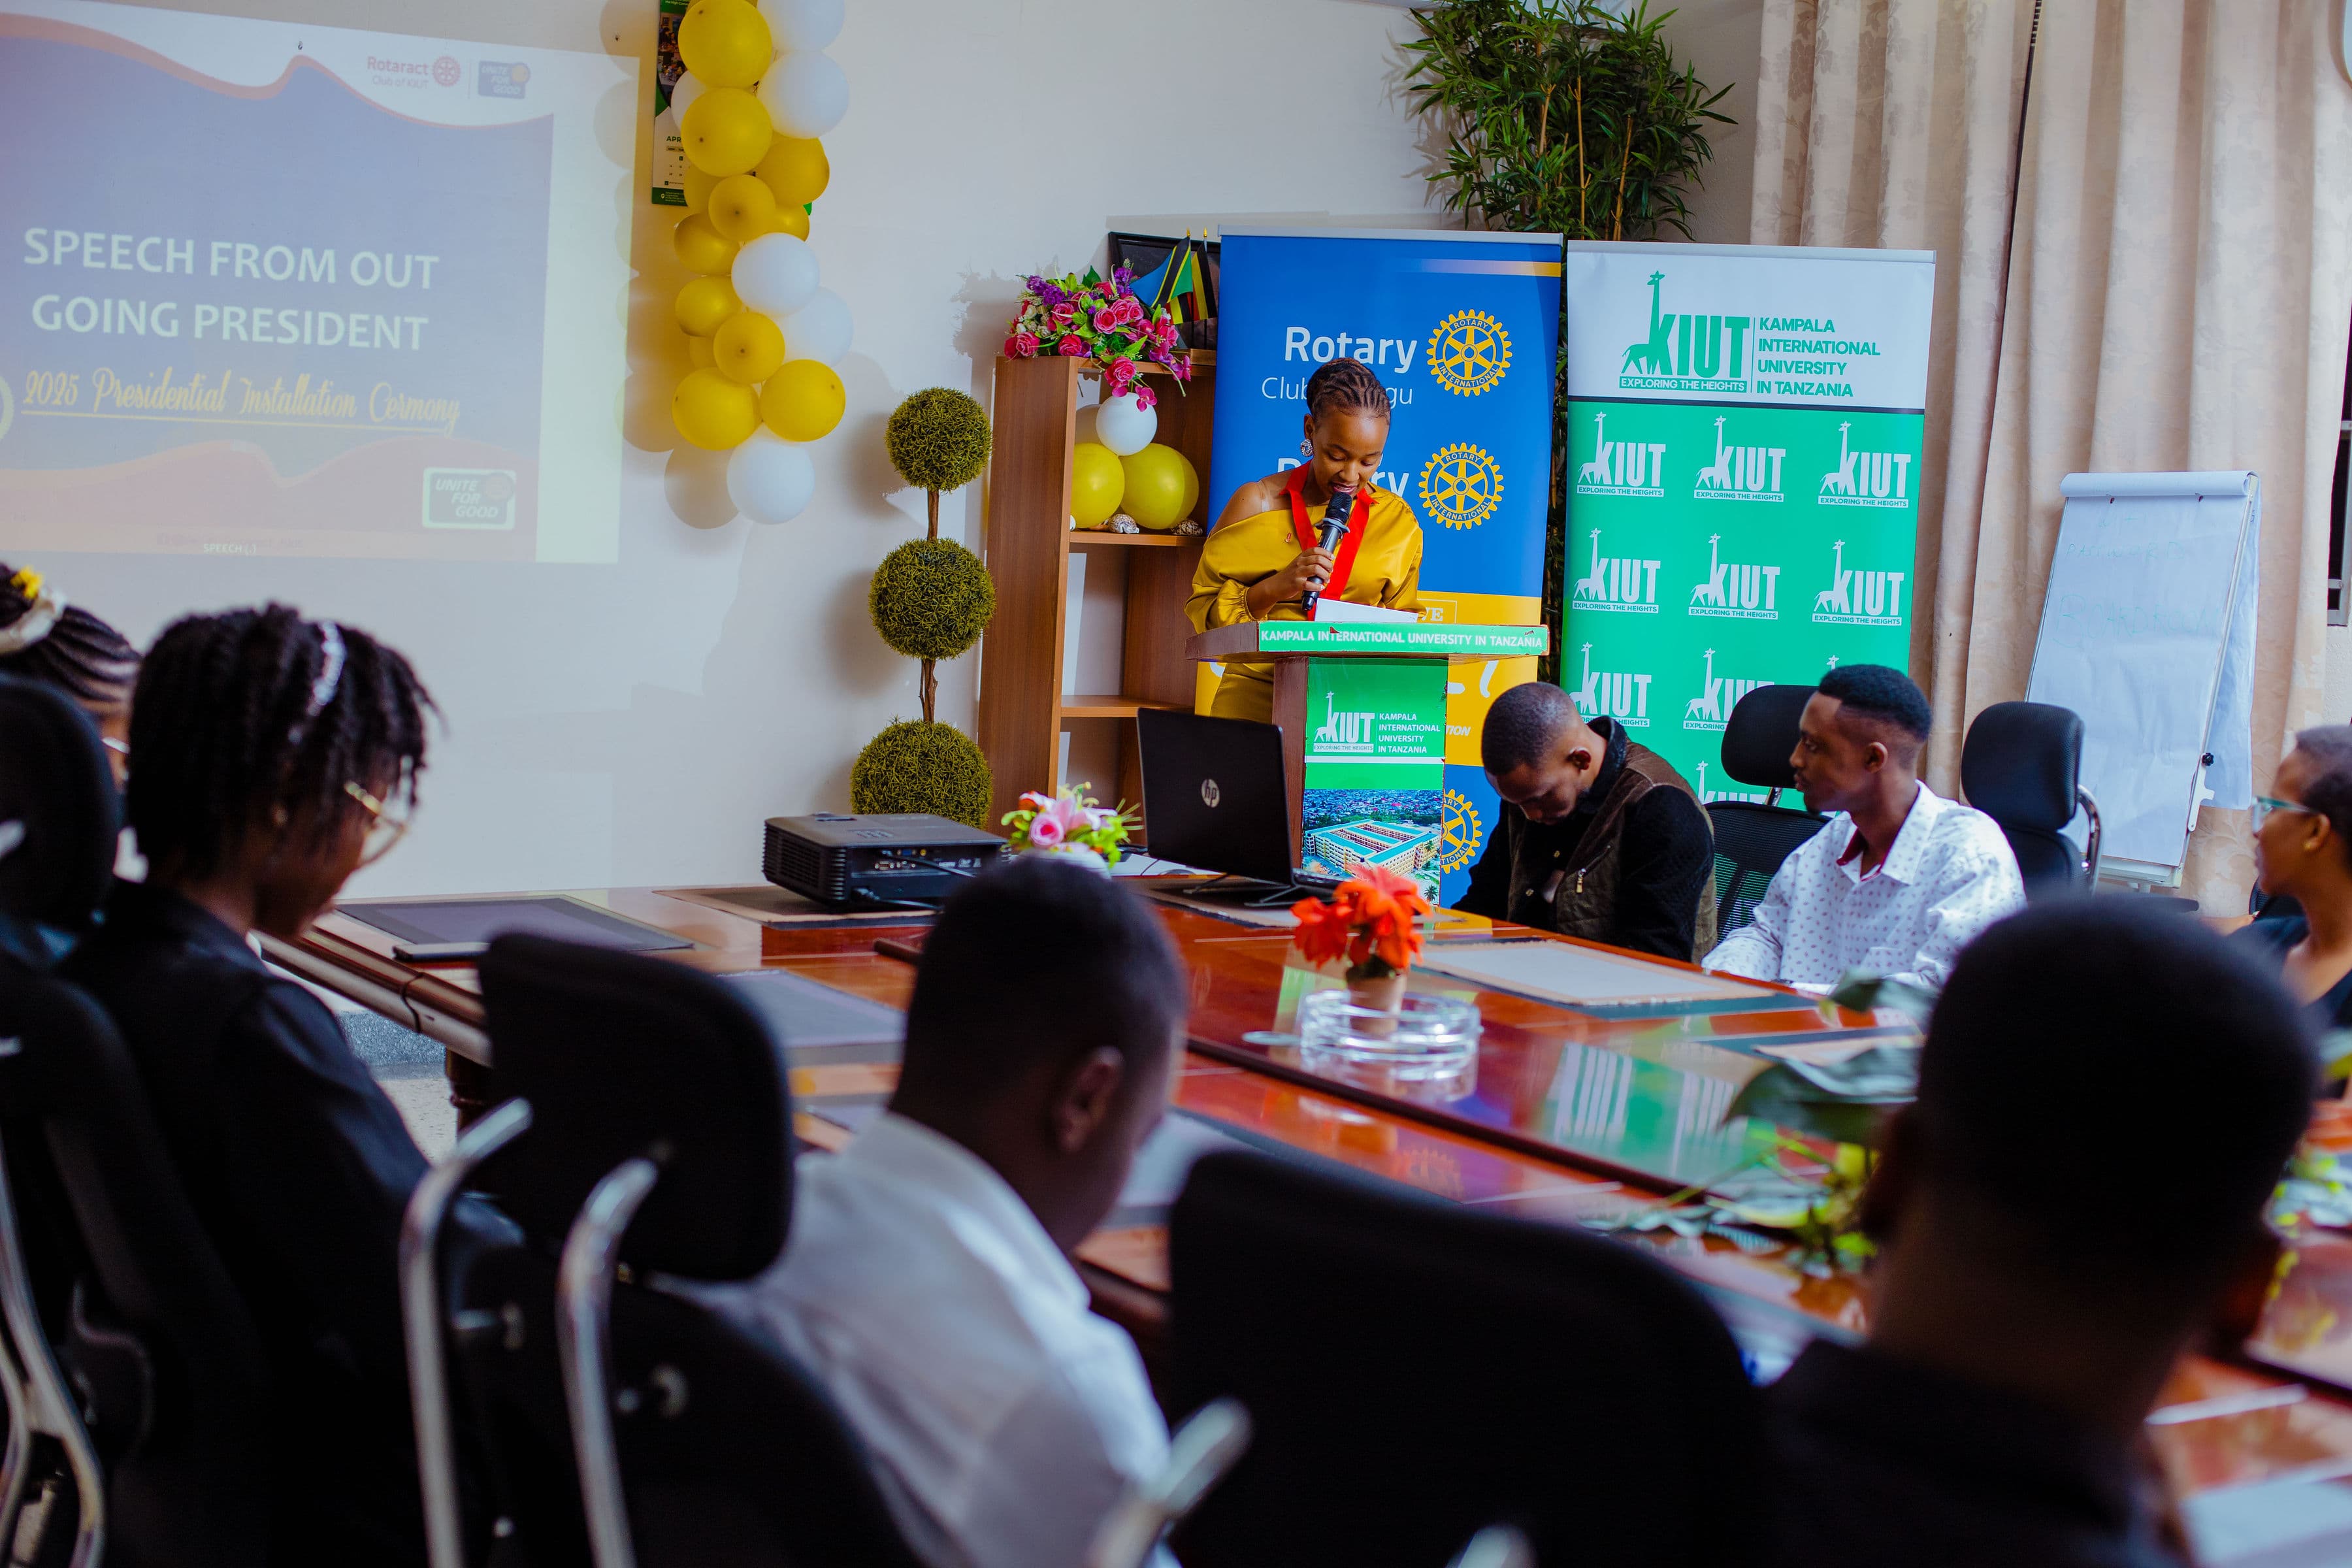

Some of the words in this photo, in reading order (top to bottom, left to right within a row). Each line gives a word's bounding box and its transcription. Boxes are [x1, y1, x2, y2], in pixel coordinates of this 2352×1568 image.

[367, 56, 428, 75] Rotaract
[372, 75, 393, 86] Club
[24, 227, 194, 274] SPEECH
[209, 242, 336, 284] FROM
[350, 251, 439, 289] OUT
[32, 295, 179, 338] GOING
[193, 304, 429, 350] PRESIDENT
[1453, 319, 1488, 329] ROTARY
[1759, 318, 1835, 333] KAMPALA
[1284, 327, 1417, 374] Rotary
[1650, 314, 1750, 378] KIUT
[1758, 338, 1881, 356] INTERNATIONAL
[1439, 365, 1498, 387] INTERNATIONAL
[1757, 359, 1848, 376] UNIVERSITY
[23, 370, 80, 406] 2025
[91, 366, 232, 414] Presidential
[238, 374, 357, 419] Installation
[1621, 376, 1678, 389] EXPLORING
[1679, 379, 1699, 390] THE
[1700, 380, 1745, 391] HEIGHTS
[1757, 380, 1772, 393] IN
[1774, 381, 1854, 397] TANZANIA
[1445, 452, 1480, 462] ROTARY
[1595, 442, 1666, 487] KIUT
[1715, 446, 1786, 491] KIUT
[1839, 451, 1911, 498] KIUT
[436, 479, 478, 491] UNITE
[451, 492, 481, 504] FOR
[455, 506, 498, 518] GOOD
[1431, 499, 1490, 520] INTERNATIONAL
[204, 544, 242, 554] SPEECH
[1590, 558, 1661, 603] KIUT
[1710, 563, 1780, 610] KIUT
[1833, 570, 1904, 616] KIUT
[1691, 608, 1731, 617] EXPLORING
[1261, 630, 1315, 642] KAMPALA
[1318, 631, 1405, 644] INTERNATIONAL
[1408, 633, 1471, 645] UNIVERSITY
[1475, 635, 1485, 645] IN
[1490, 635, 1543, 647] TANZANIA
[1581, 672, 1652, 717] KIUT
[1327, 712, 1375, 743] KIUT
[1445, 725, 1471, 736] TION
[1203, 778, 1218, 808] hp
[1443, 798, 1460, 808] ARY
[1442, 846, 1469, 865] TIONAL
